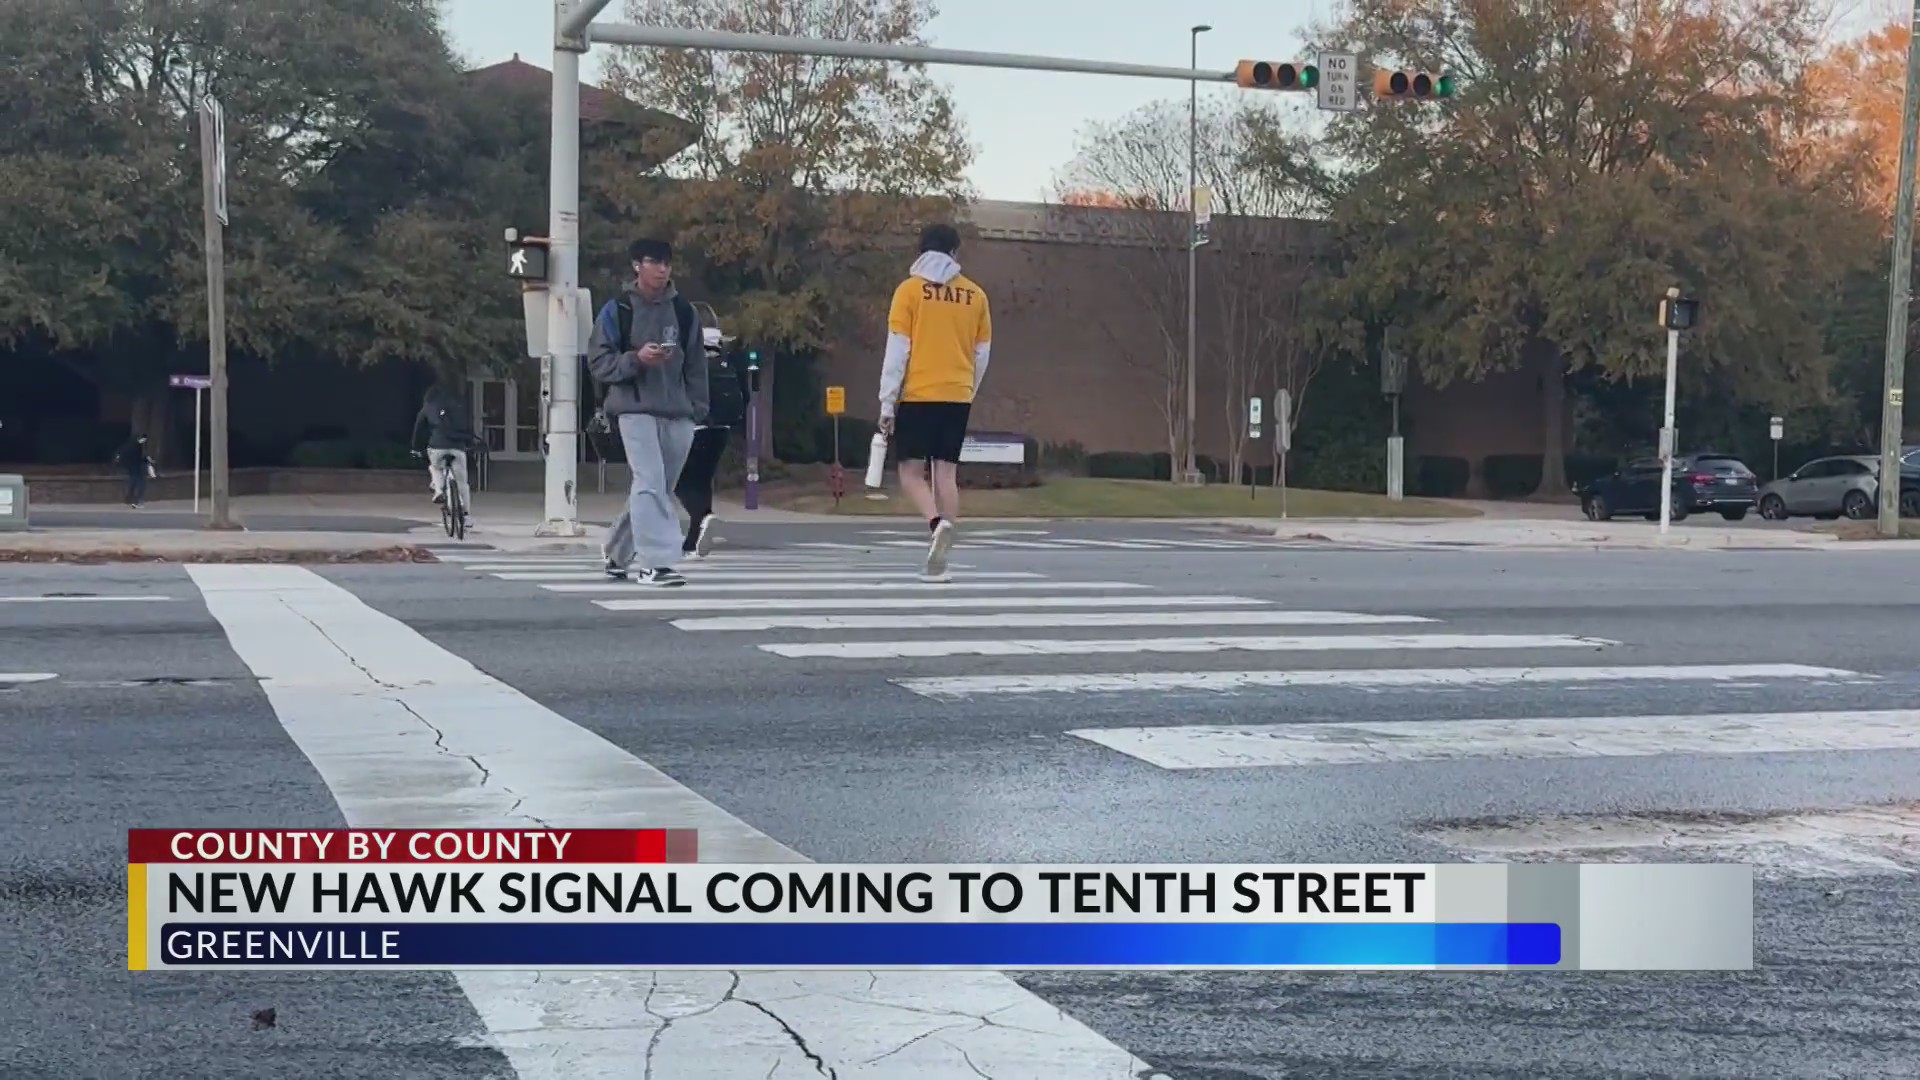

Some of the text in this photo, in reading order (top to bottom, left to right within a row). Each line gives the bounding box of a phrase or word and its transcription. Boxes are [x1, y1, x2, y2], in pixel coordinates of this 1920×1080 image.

[1328, 58, 1346, 69] NO
[1327, 71, 1349, 81] TURN
[1330, 84, 1344, 94] ON
[1328, 95, 1346, 106] RED
[922, 283, 975, 305] STAFF
